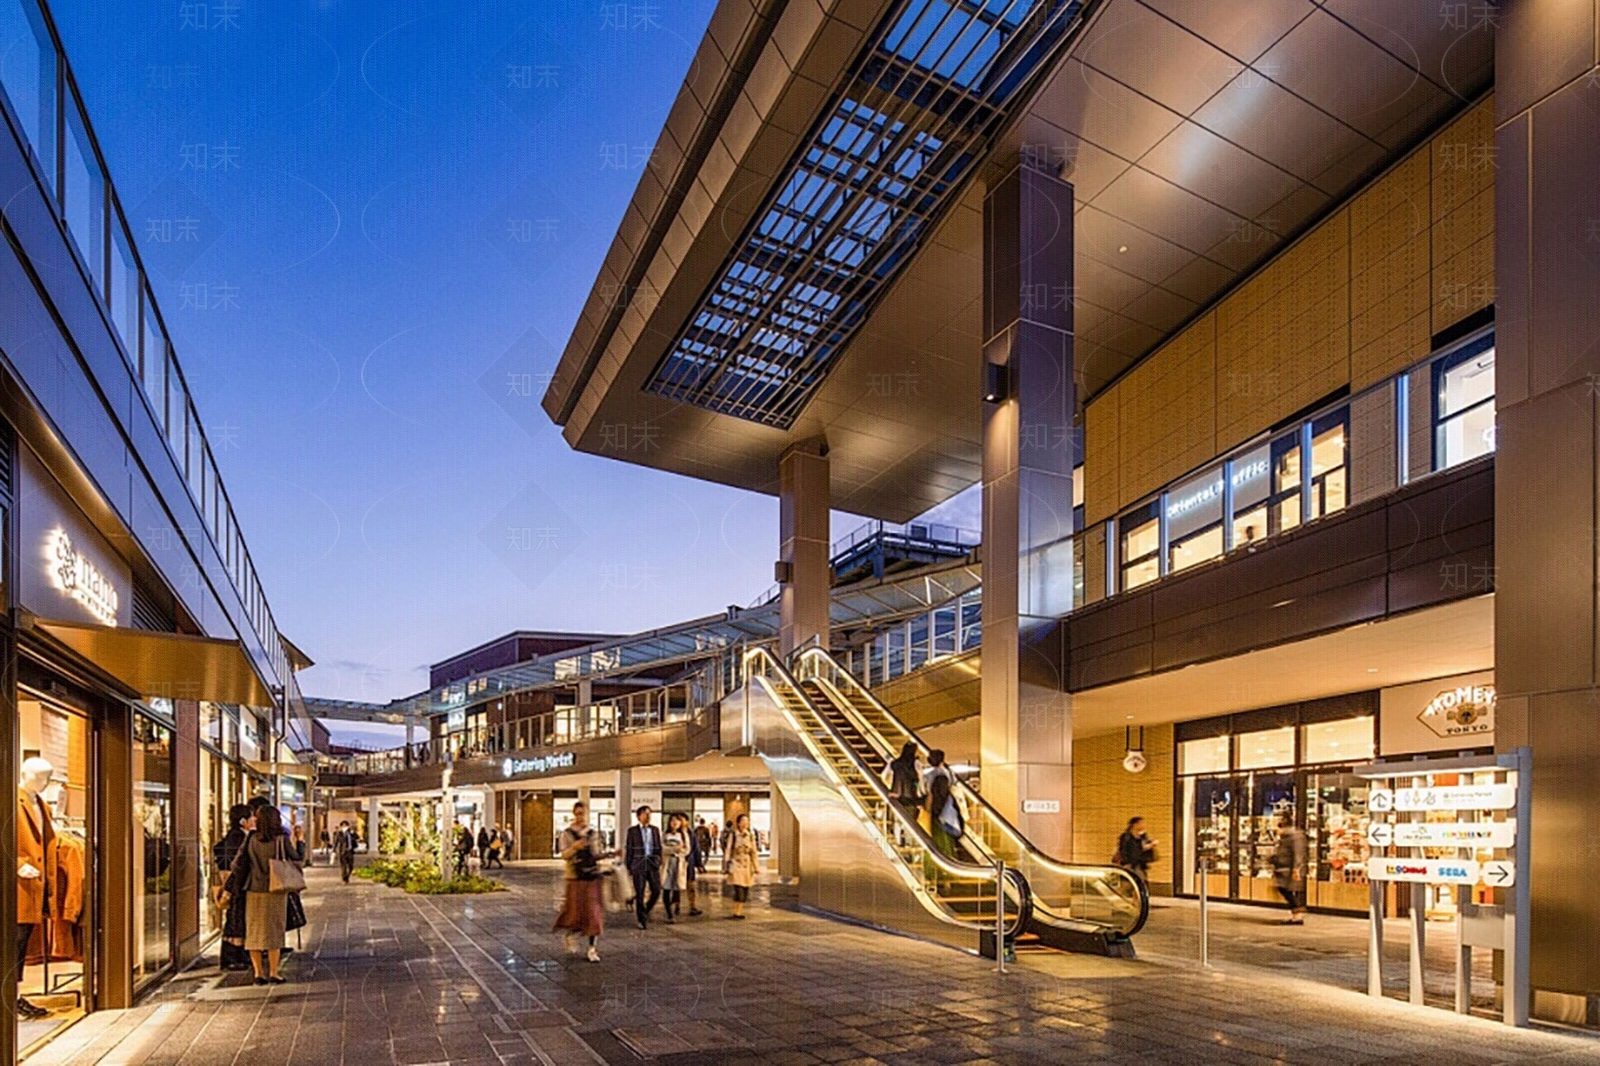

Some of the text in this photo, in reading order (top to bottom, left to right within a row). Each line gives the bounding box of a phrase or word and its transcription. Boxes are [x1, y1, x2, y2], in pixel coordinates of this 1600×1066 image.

[1424, 686, 1498, 717] AKOMEY
[1446, 724, 1488, 734] TOKYO
[545, 752, 573, 768] Market
[1438, 867, 1467, 877] SEGA
